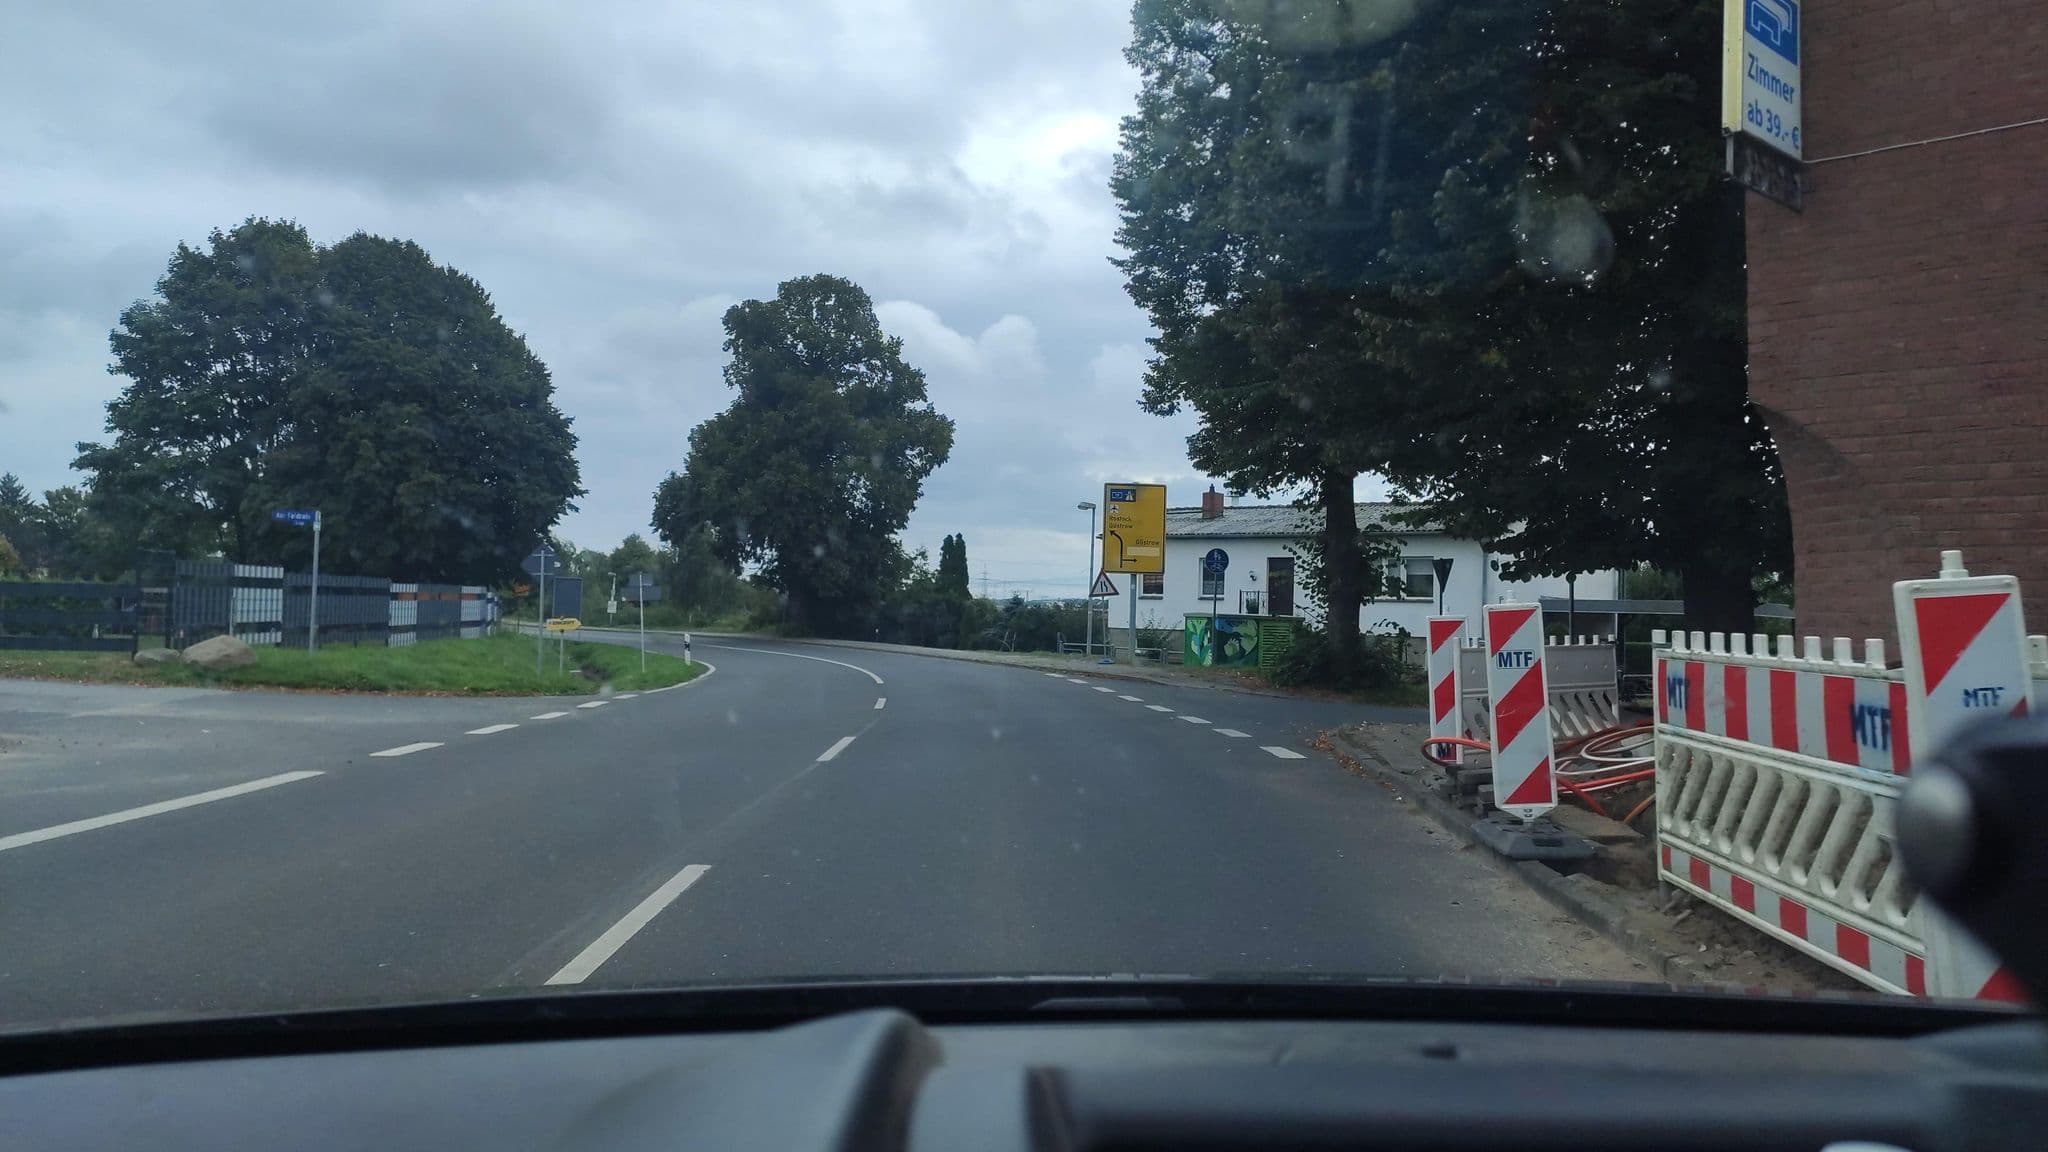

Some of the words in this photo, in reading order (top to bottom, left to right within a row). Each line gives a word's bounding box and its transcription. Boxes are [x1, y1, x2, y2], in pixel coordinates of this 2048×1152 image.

[1747, 53, 1795, 104] Zimmer
[1748, 99, 1763, 126] ab
[1497, 650, 1534, 669] MTF
[1666, 676, 1691, 711] MTF
[1962, 685, 2005, 708] MTF
[1850, 703, 1893, 752] MTF
